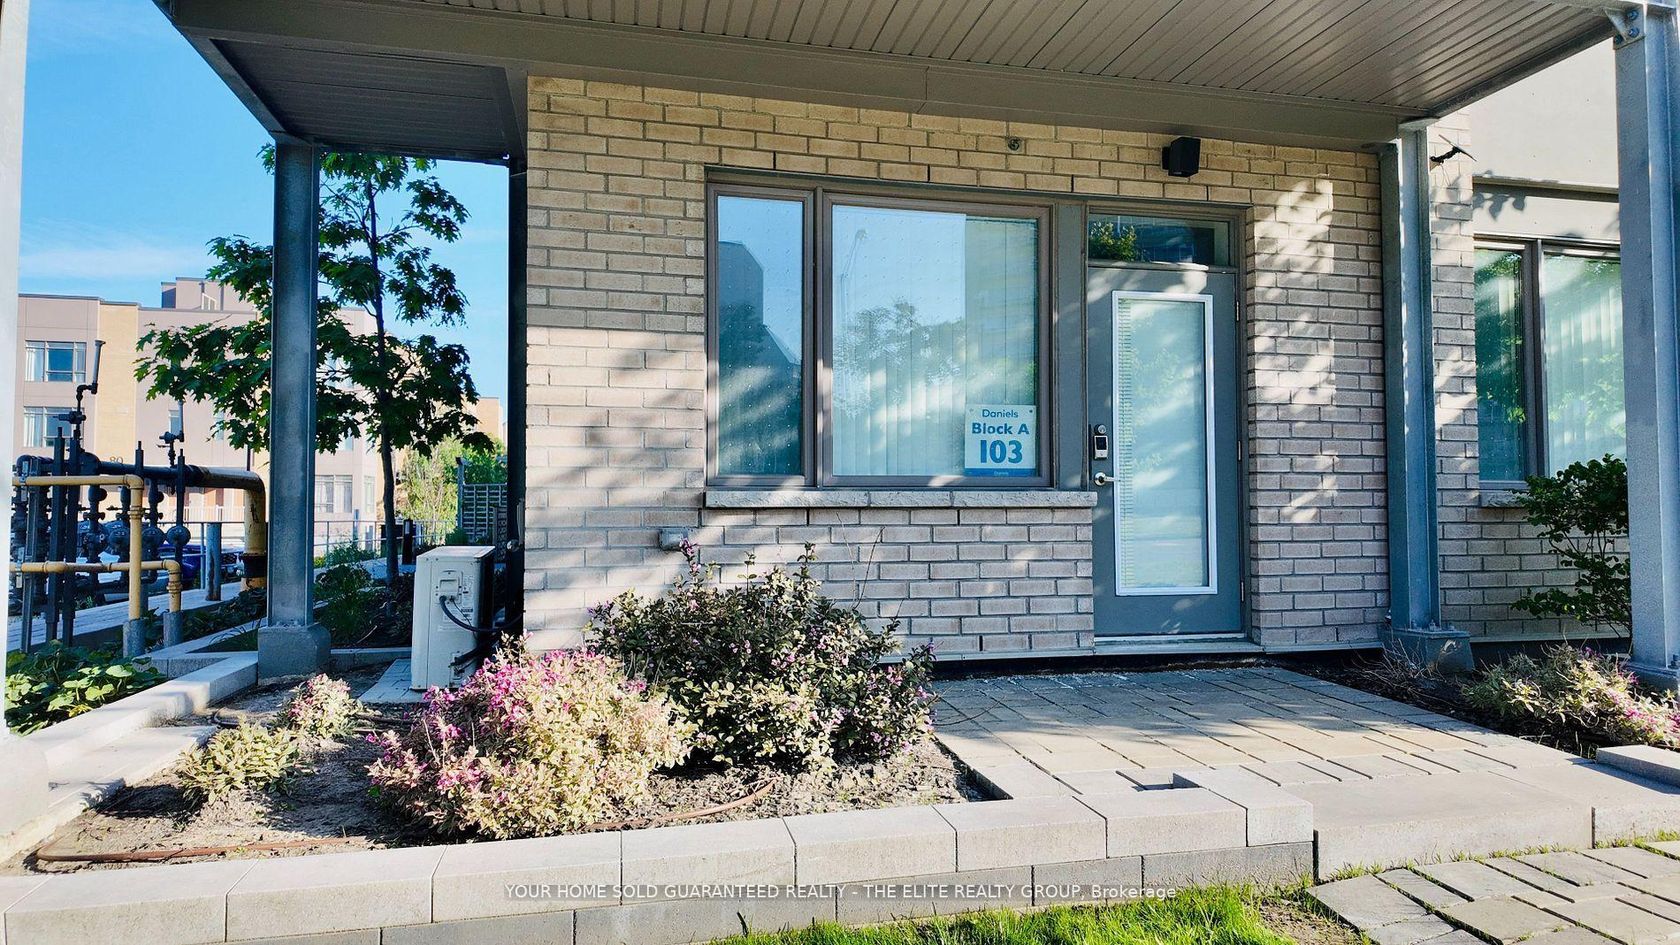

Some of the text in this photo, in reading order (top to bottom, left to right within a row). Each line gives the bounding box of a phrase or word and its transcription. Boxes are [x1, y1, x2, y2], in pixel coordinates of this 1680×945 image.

[982, 409, 1019, 418] Daniels
[972, 423, 1029, 434] Block A
[980, 440, 1022, 463] 103
